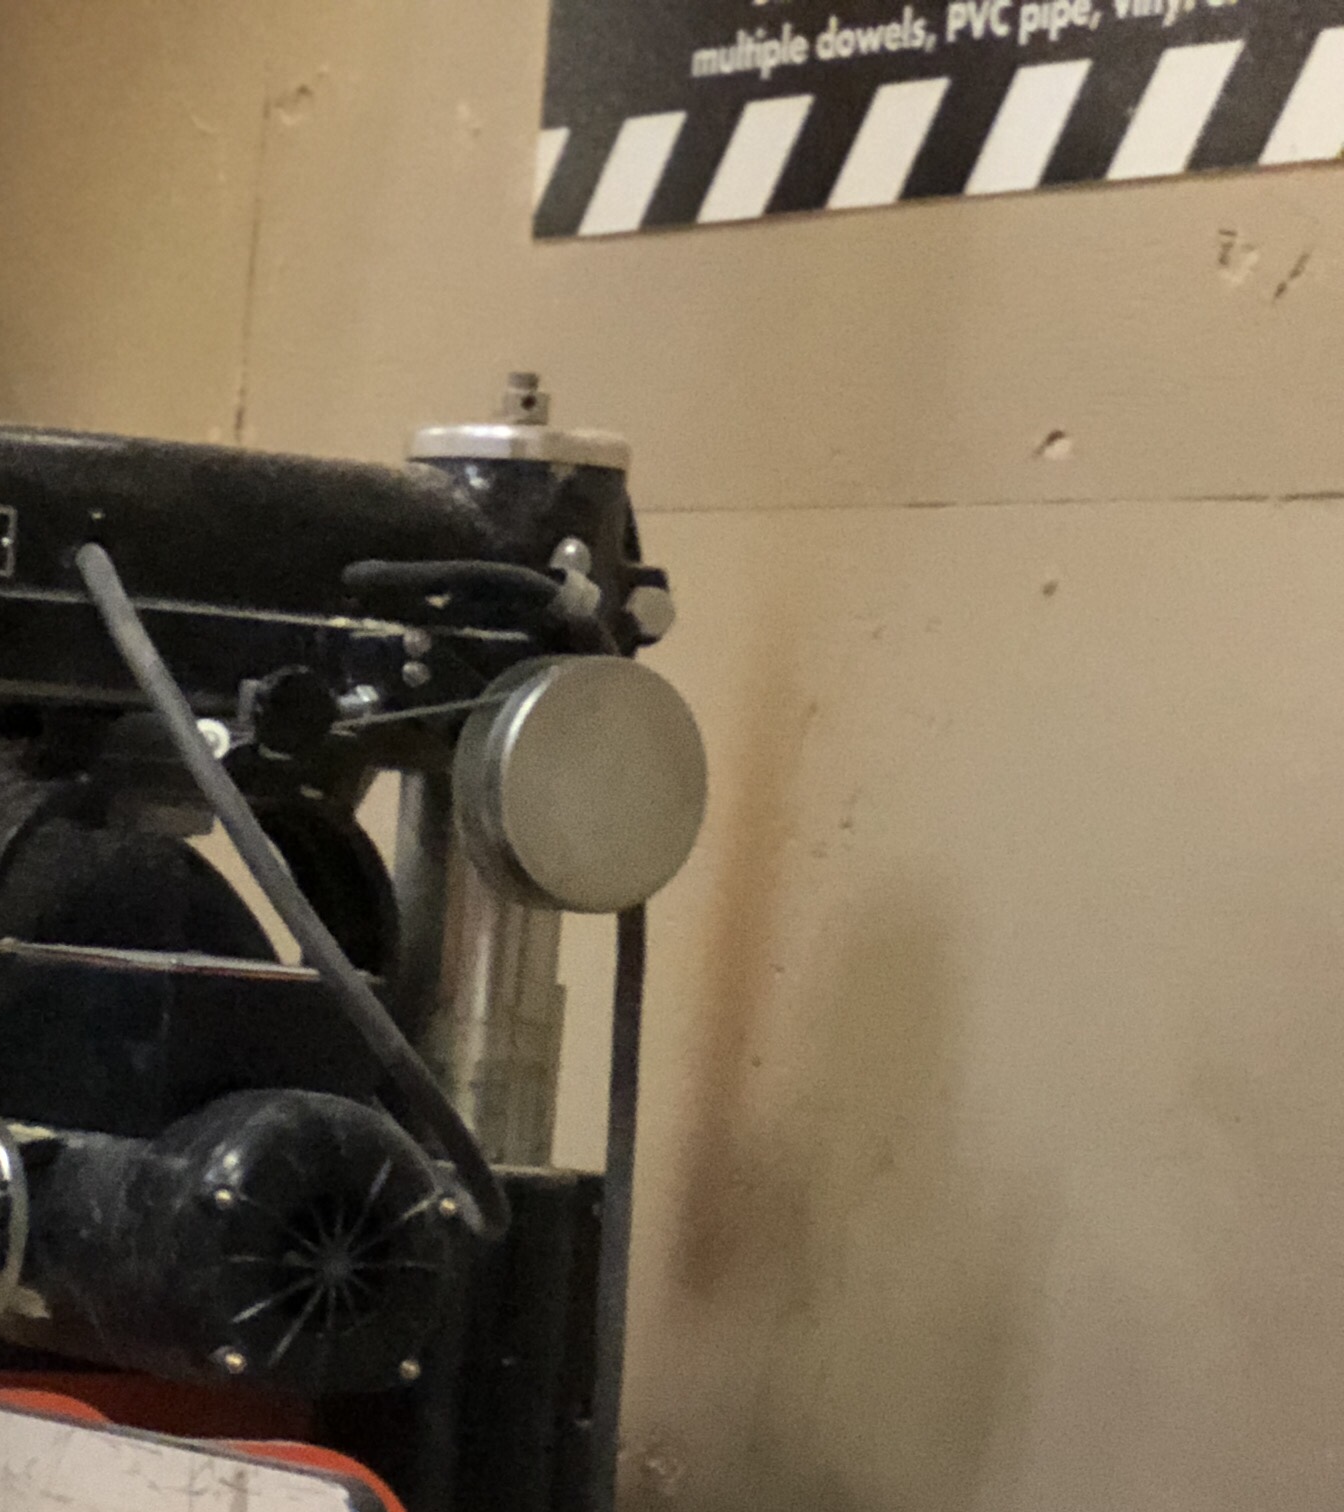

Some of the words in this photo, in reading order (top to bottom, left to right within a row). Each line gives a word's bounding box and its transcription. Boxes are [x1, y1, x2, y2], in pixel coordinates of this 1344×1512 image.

[691, 21, 810, 80] multiple
[815, 4, 938, 53] dowels,
[946, 0, 1011, 43] PVC
[1017, 0, 1102, 46] pipe,
